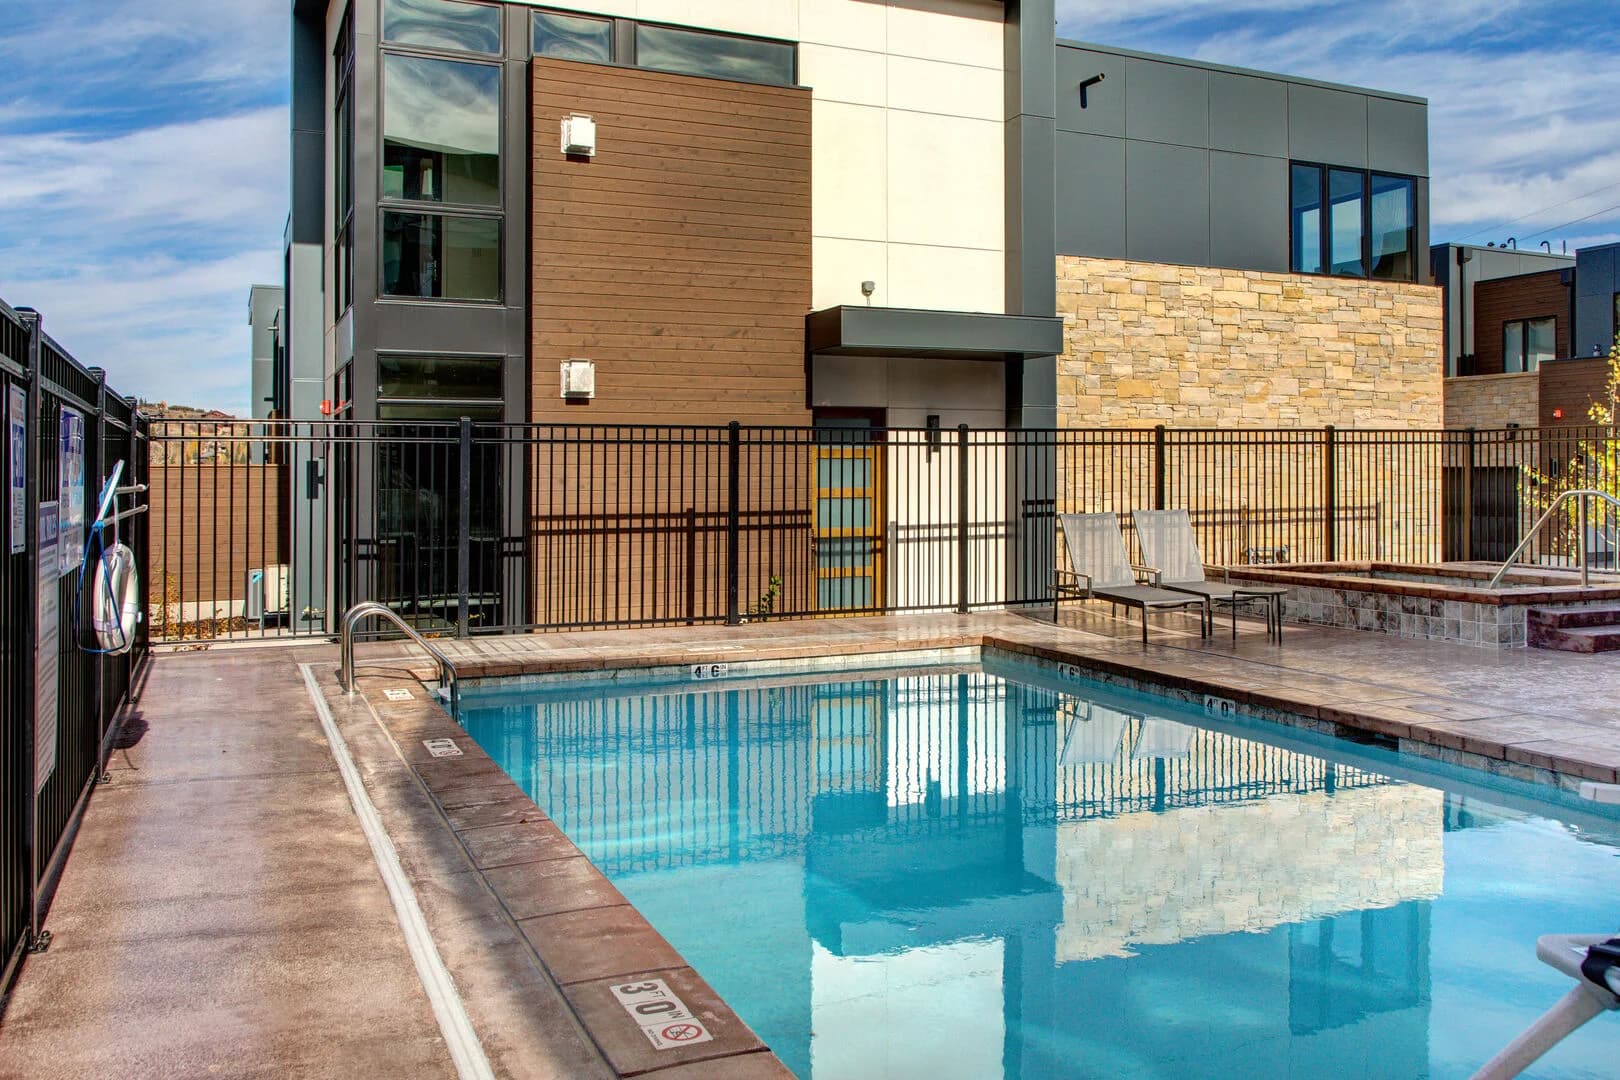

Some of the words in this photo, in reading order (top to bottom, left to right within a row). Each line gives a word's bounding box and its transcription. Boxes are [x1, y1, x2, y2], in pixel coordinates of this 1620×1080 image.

[619, 982, 660, 995] 3
[649, 990, 667, 998] FT
[635, 1000, 678, 1016] 0
[667, 1010, 686, 1019] IN
